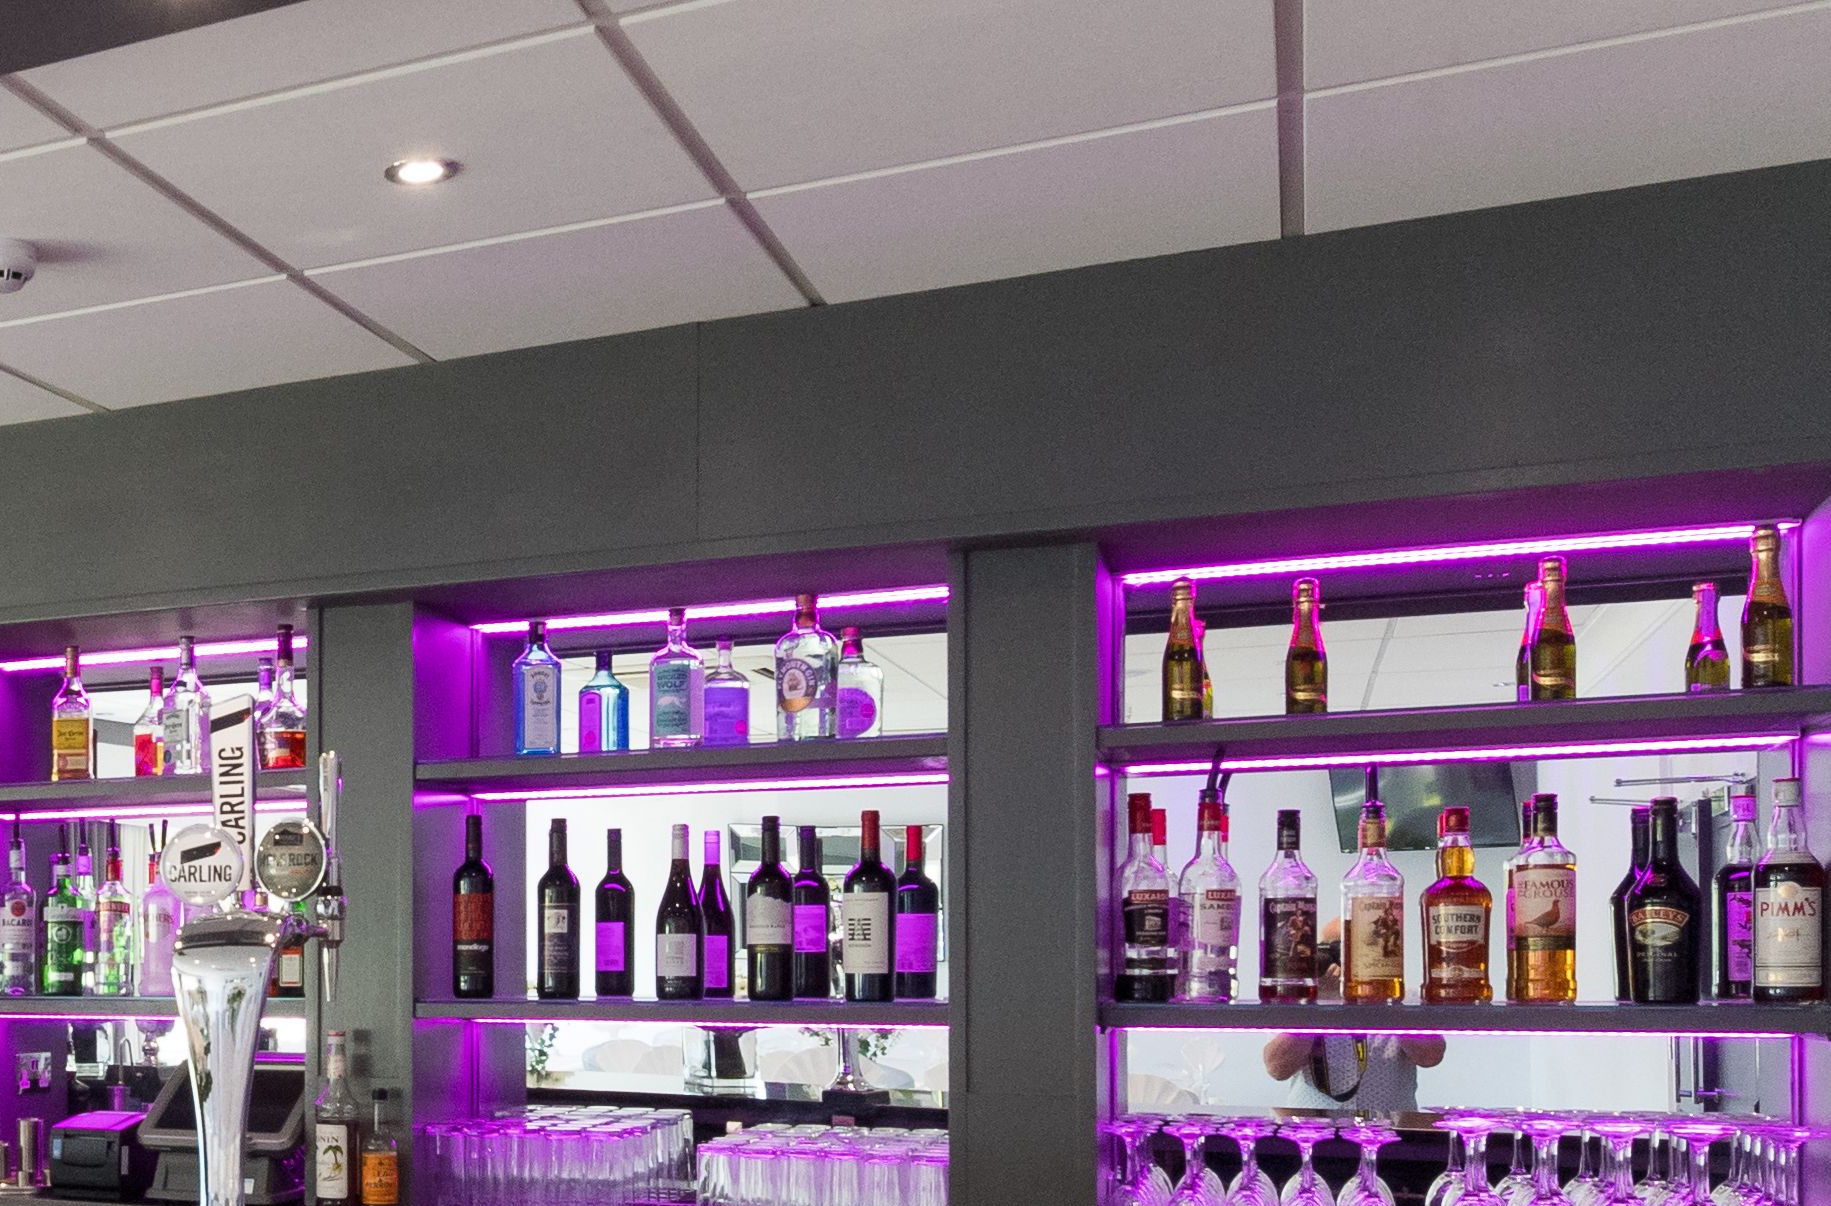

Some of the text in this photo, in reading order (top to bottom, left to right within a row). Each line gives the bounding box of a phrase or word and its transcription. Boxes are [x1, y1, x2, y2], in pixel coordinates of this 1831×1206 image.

[169, 864, 232, 883] CARLING
[1760, 898, 1816, 918] PIMM'S
[1432, 912, 1481, 924] SOUTHERN
[1434, 924, 1479, 935] COMFORT
